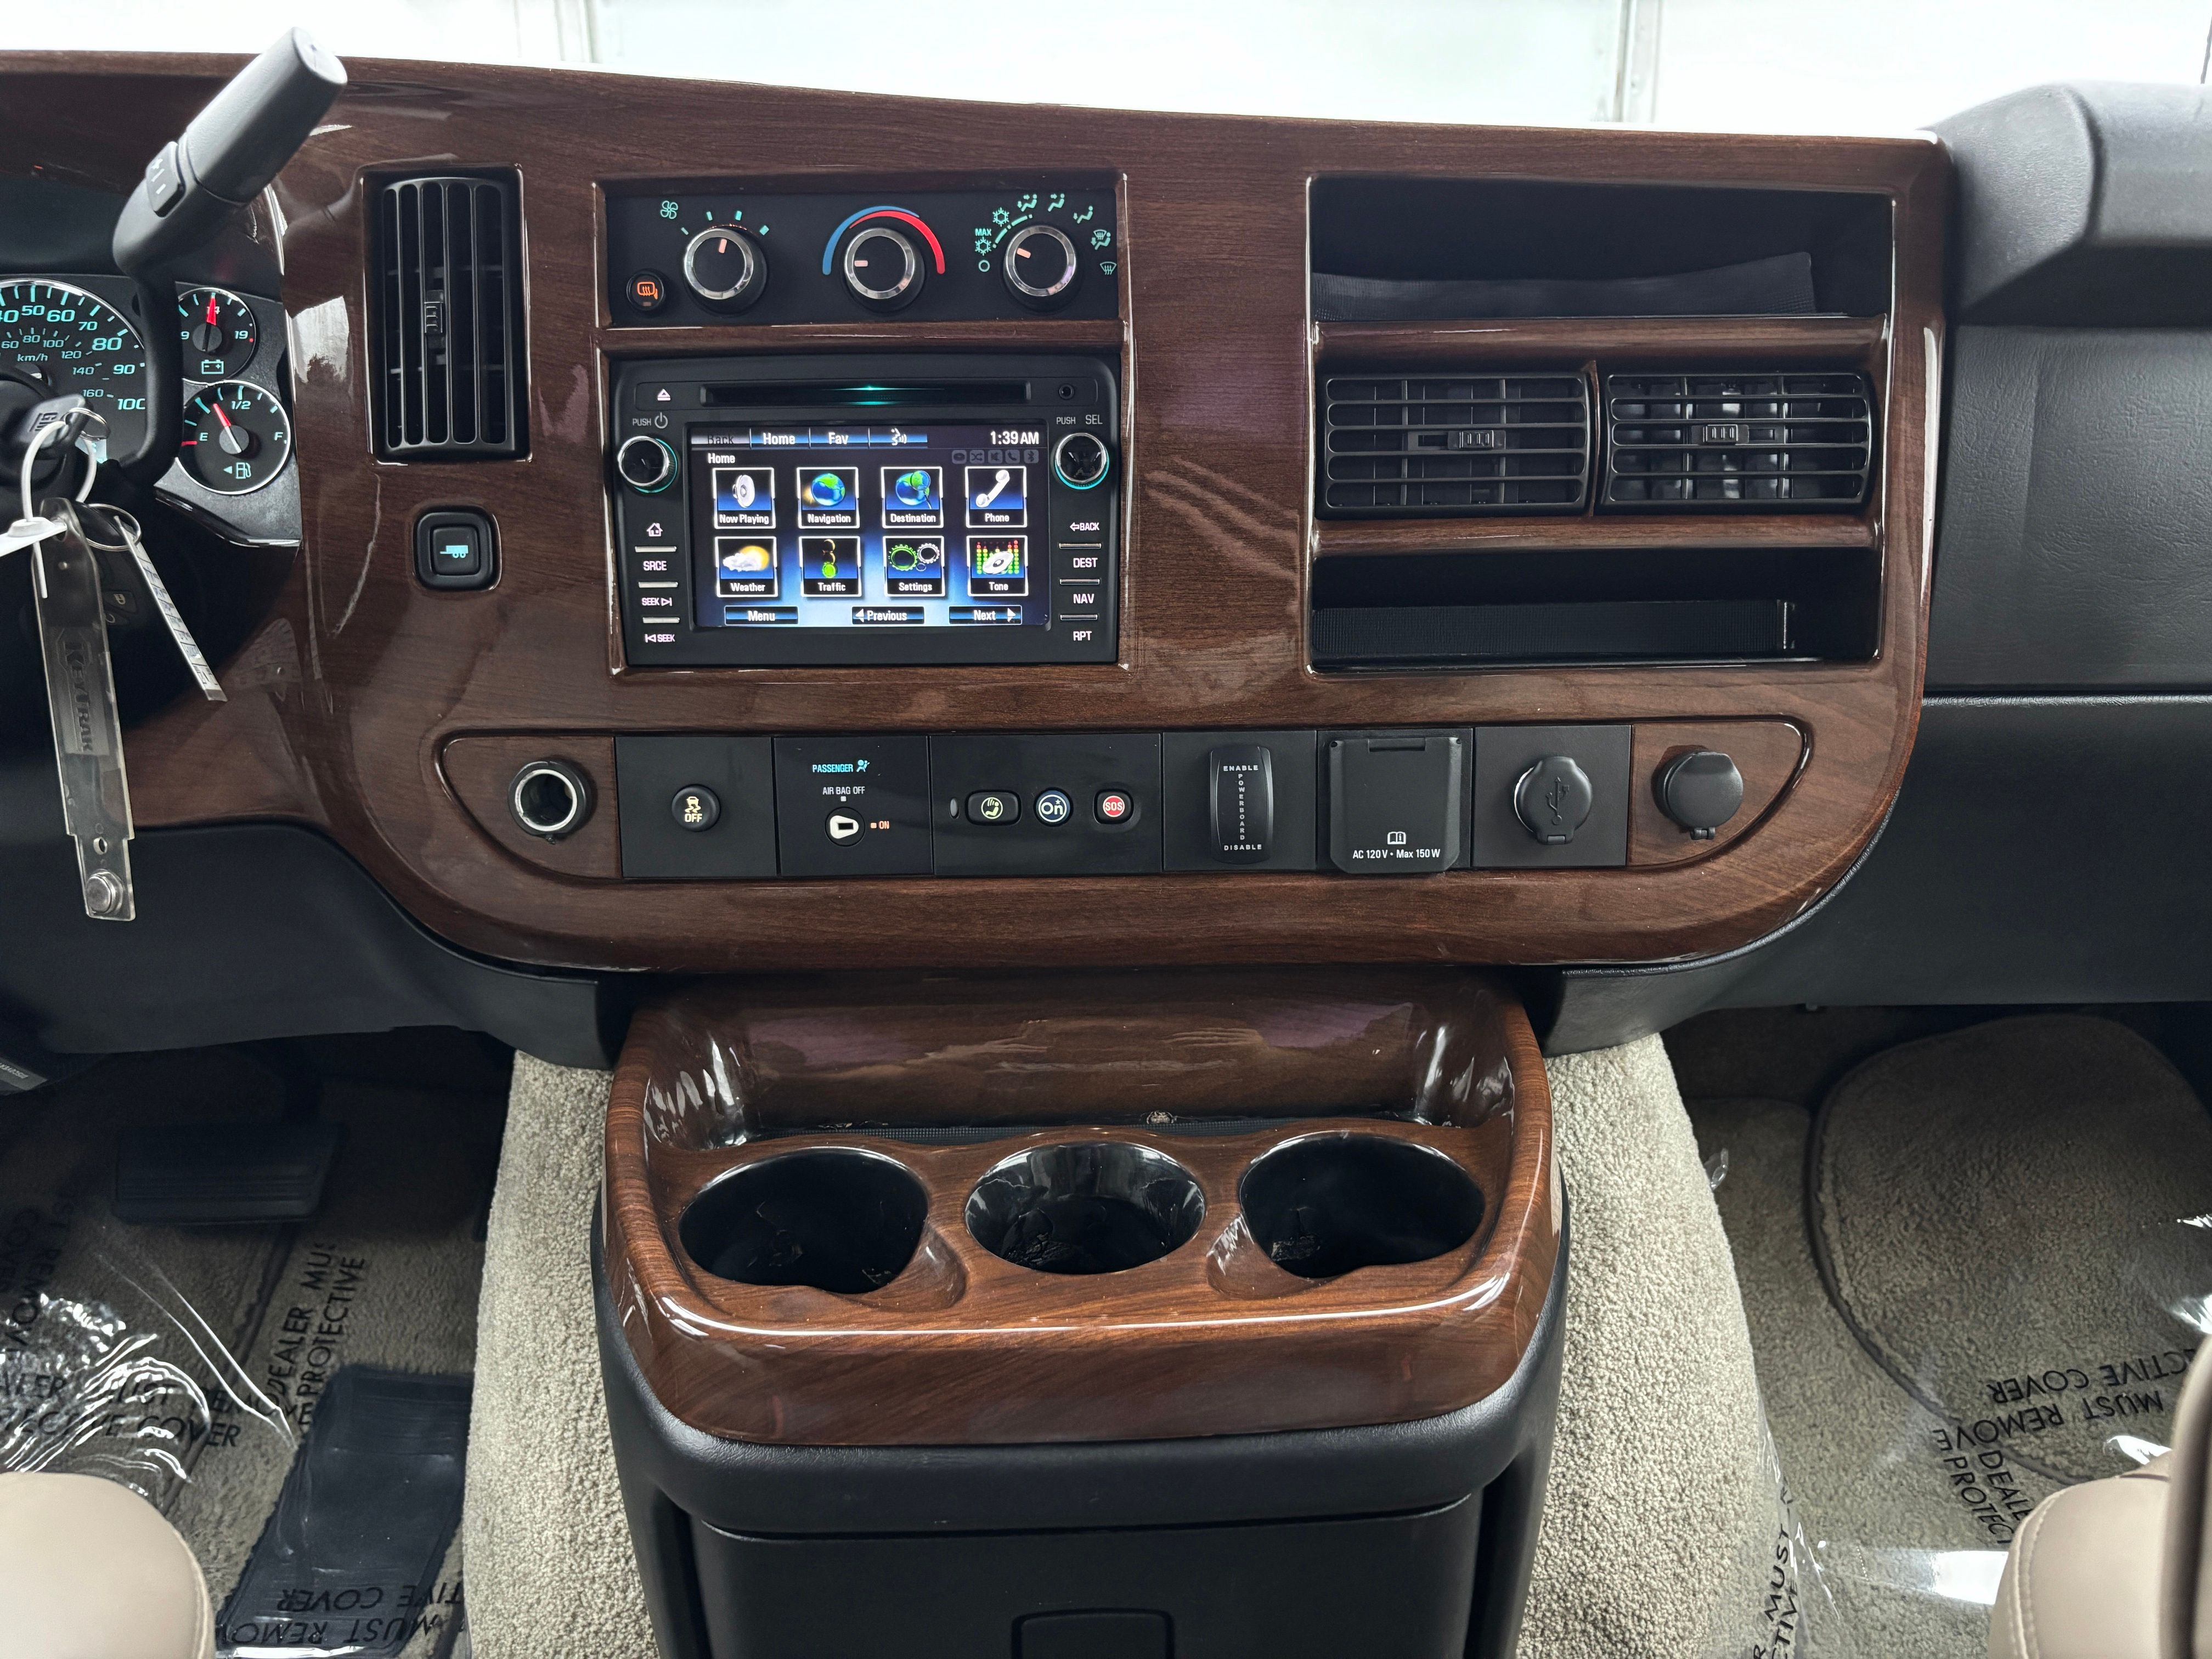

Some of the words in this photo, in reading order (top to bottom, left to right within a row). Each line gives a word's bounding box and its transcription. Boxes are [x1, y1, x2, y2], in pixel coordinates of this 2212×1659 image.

[21, 305, 45, 315] 50
[0, 310, 19, 323] 0
[47, 309, 75, 322] 60
[78, 321, 98, 331] 70
[22, 335, 40, 343] 80
[234, 330, 249, 339] 19
[1, 341, 19, 349] 60
[43, 340, 64, 348] 100
[92, 337, 122, 351] 80
[61, 351, 82, 359] 120
[73, 366, 94, 375] 140
[113, 364, 135, 374] 90
[83, 389, 104, 397] 160
[232, 400, 251, 410] 1/2
[633, 418, 652, 426] PUSH
[1056, 416, 1076, 425] PUSH
[1085, 415, 1103, 425] SEL
[200, 433, 208, 441] E
[275, 432, 283, 441] F
[763, 432, 795, 444] Home
[828, 432, 849, 444] Fav
[708, 453, 736, 464] Home
[719, 514, 738, 523] Now
[741, 514, 769, 524] Playing
[808, 514, 851, 524] Navigation
[890, 514, 936, 523] Destination
[985, 512, 1009, 522] Phone
[1080, 522, 1100, 531] BACK
[643, 561, 667, 571] SRCE
[1073, 557, 1098, 568] DEST
[730, 582, 766, 592] Weather
[817, 582, 846, 591] Traffic
[899, 582, 933, 592] Settings
[989, 582, 1008, 590] Tone
[642, 597, 660, 606] SEEK
[1073, 594, 1094, 604] NAV
[748, 610, 775, 622] Menu
[867, 610, 907, 621] Previous
[974, 610, 996, 621] Next
[657, 634, 675, 642] SEEK
[1073, 631, 1092, 641] RPT
[812, 764, 854, 772] PASSENGER
[822, 787, 834, 795] AIR
[836, 787, 851, 795] BAG
[853, 786, 865, 794] OFF
[1105, 802, 1123, 811] SOS
[685, 813, 702, 822] OFF
[879, 821, 889, 830] ON
[1352, 850, 1364, 859] AC
[1396, 849, 1413, 858] Max
[297, 1256, 365, 1397] PROTECTIVE
[267, 1307, 314, 1397] DEALER
[1987, 1368, 2090, 1404] COVER
[2081, 1390, 2164, 1420] MUST
[1932, 1403, 2064, 1451] REMOVE
[1764, 1523, 1789, 1622] MUST
[276, 1587, 384, 1613] COVER
[230, 1620, 329, 1645] REMO
[349, 1614, 440, 1644] MUST
